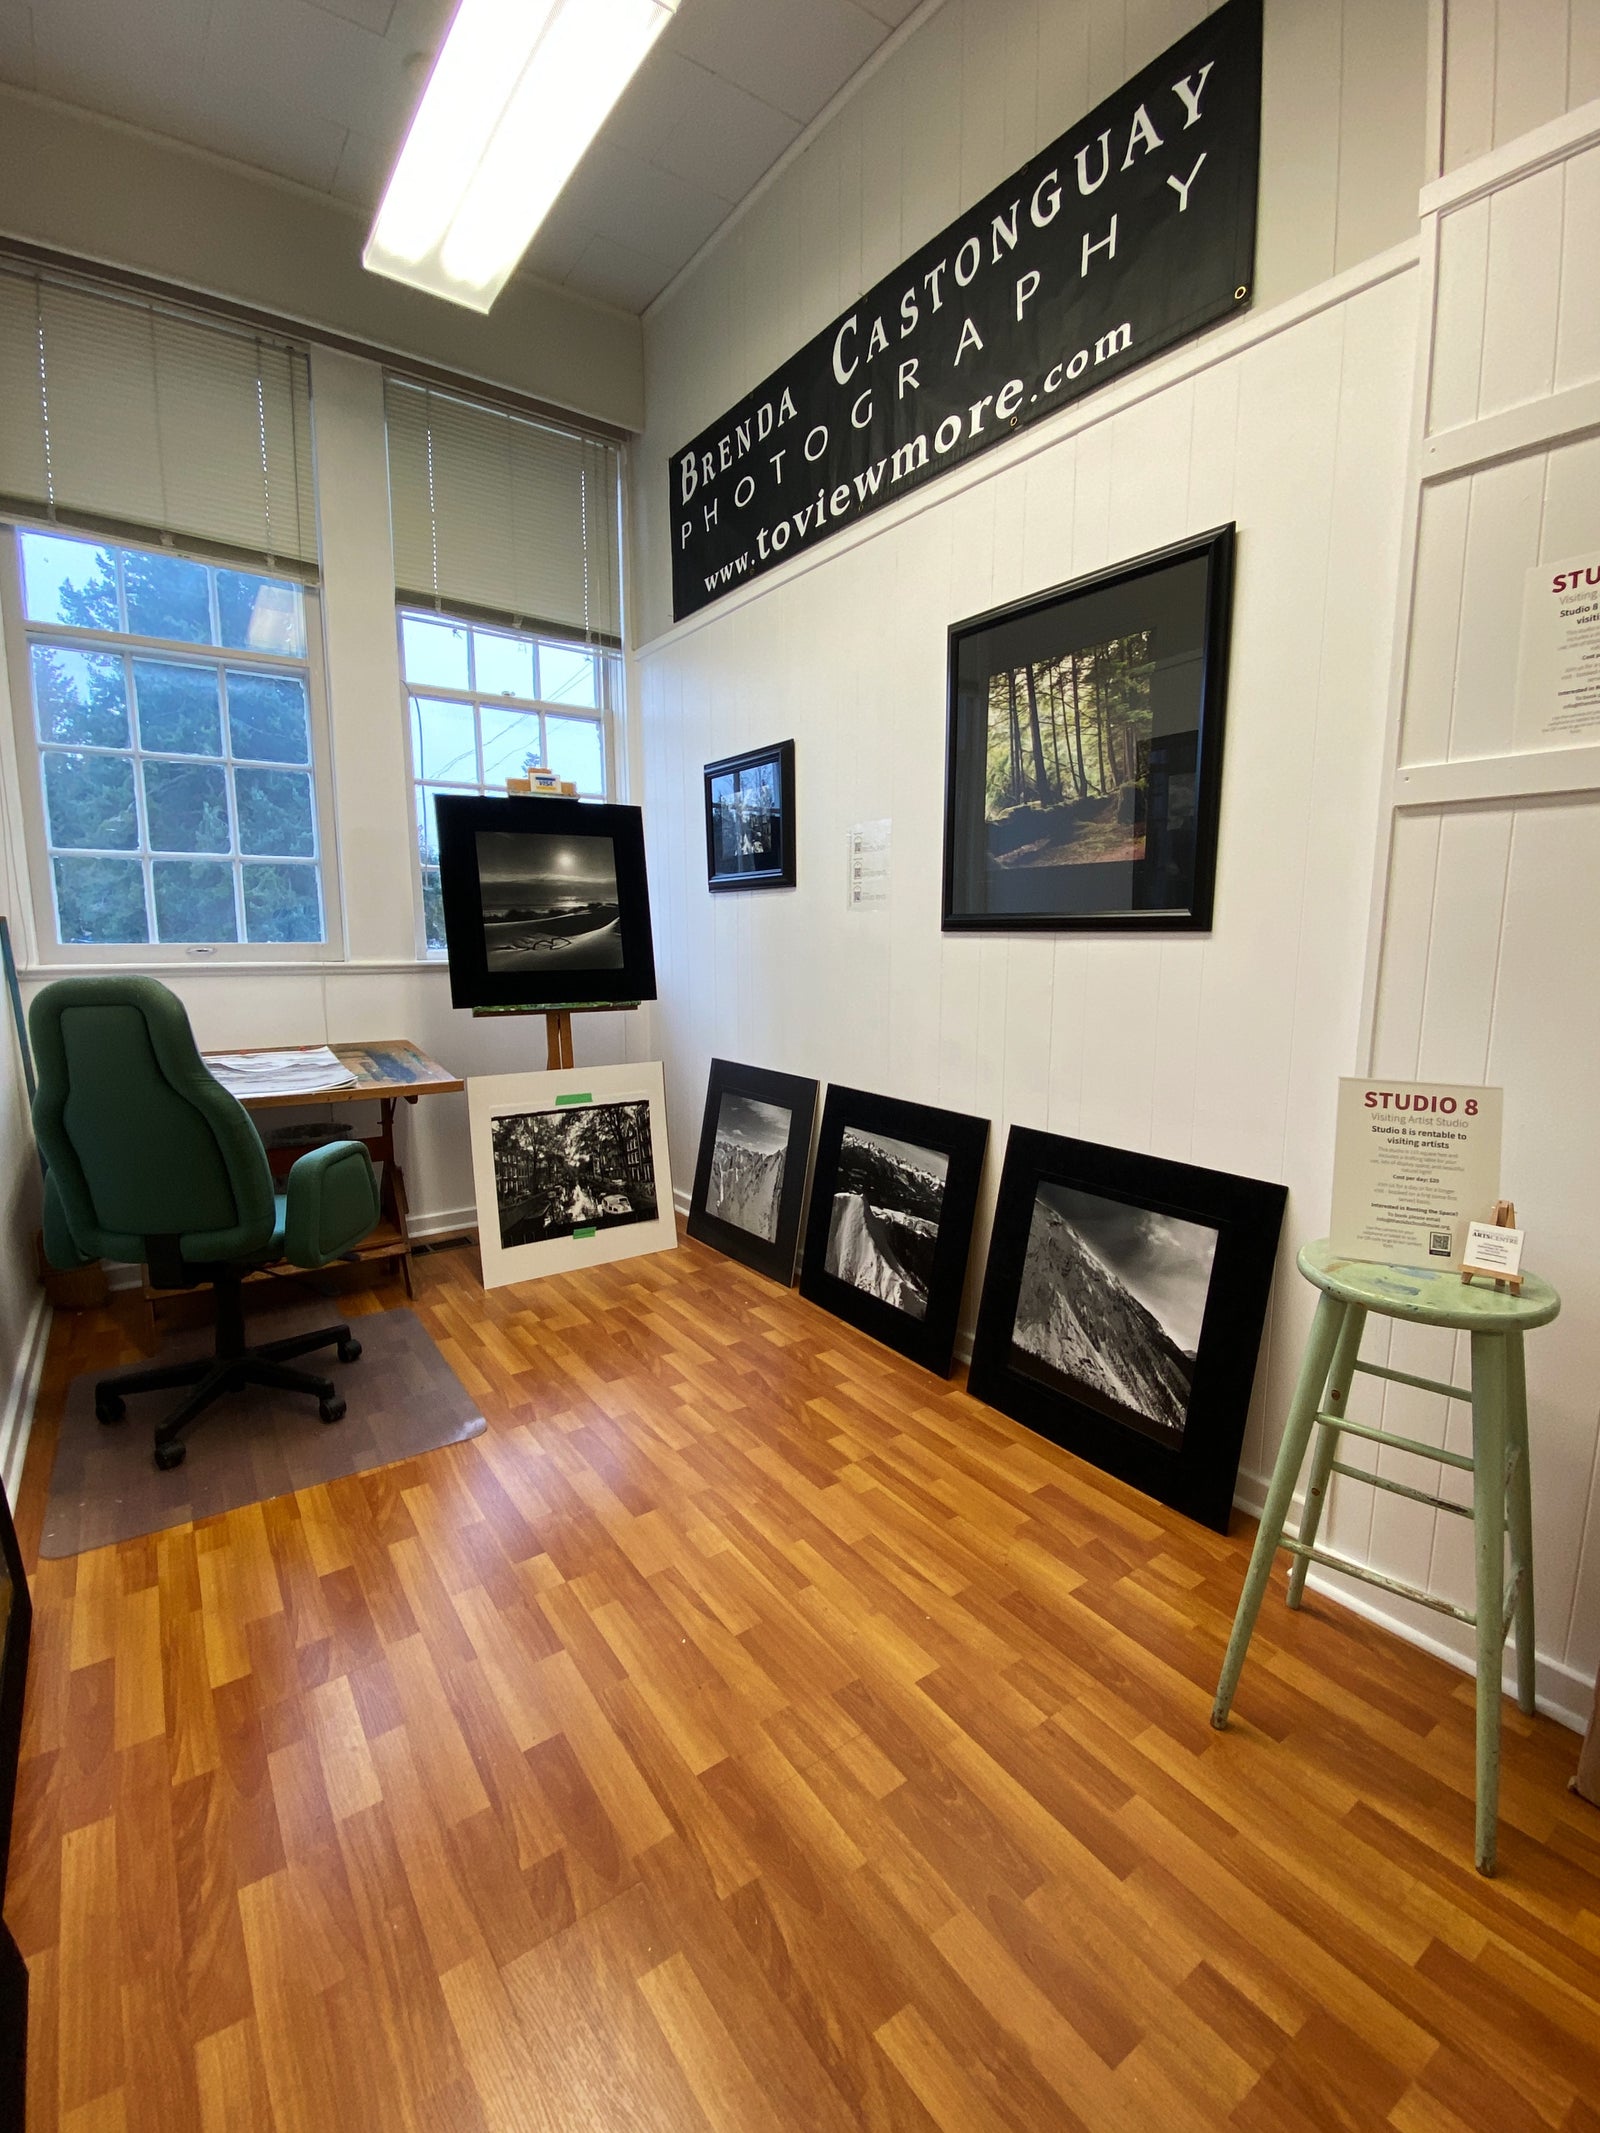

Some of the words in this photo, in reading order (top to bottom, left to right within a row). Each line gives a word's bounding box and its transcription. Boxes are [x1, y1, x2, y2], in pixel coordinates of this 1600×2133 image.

[680, 386, 798, 505] BRENDA
[832, 60, 1216, 385] CASTONGUAY
[704, 320, 1133, 592] www.toviewmore.com
[1559, 591, 1597, 605] Visiting
[1560, 606, 1590, 617] Studio
[1364, 1092, 1457, 1114] STUDIO
[1464, 1099, 1478, 1115] 8
[1371, 1113, 1406, 1125] Visiting
[1408, 1115, 1433, 1125] Artist
[1436, 1118, 1468, 1128] Studio
[1372, 1126, 1399, 1134] Studio
[1418, 1131, 1455, 1139] rentable
[1387, 1137, 1419, 1147] visiting
[1421, 1141, 1449, 1149] artists
